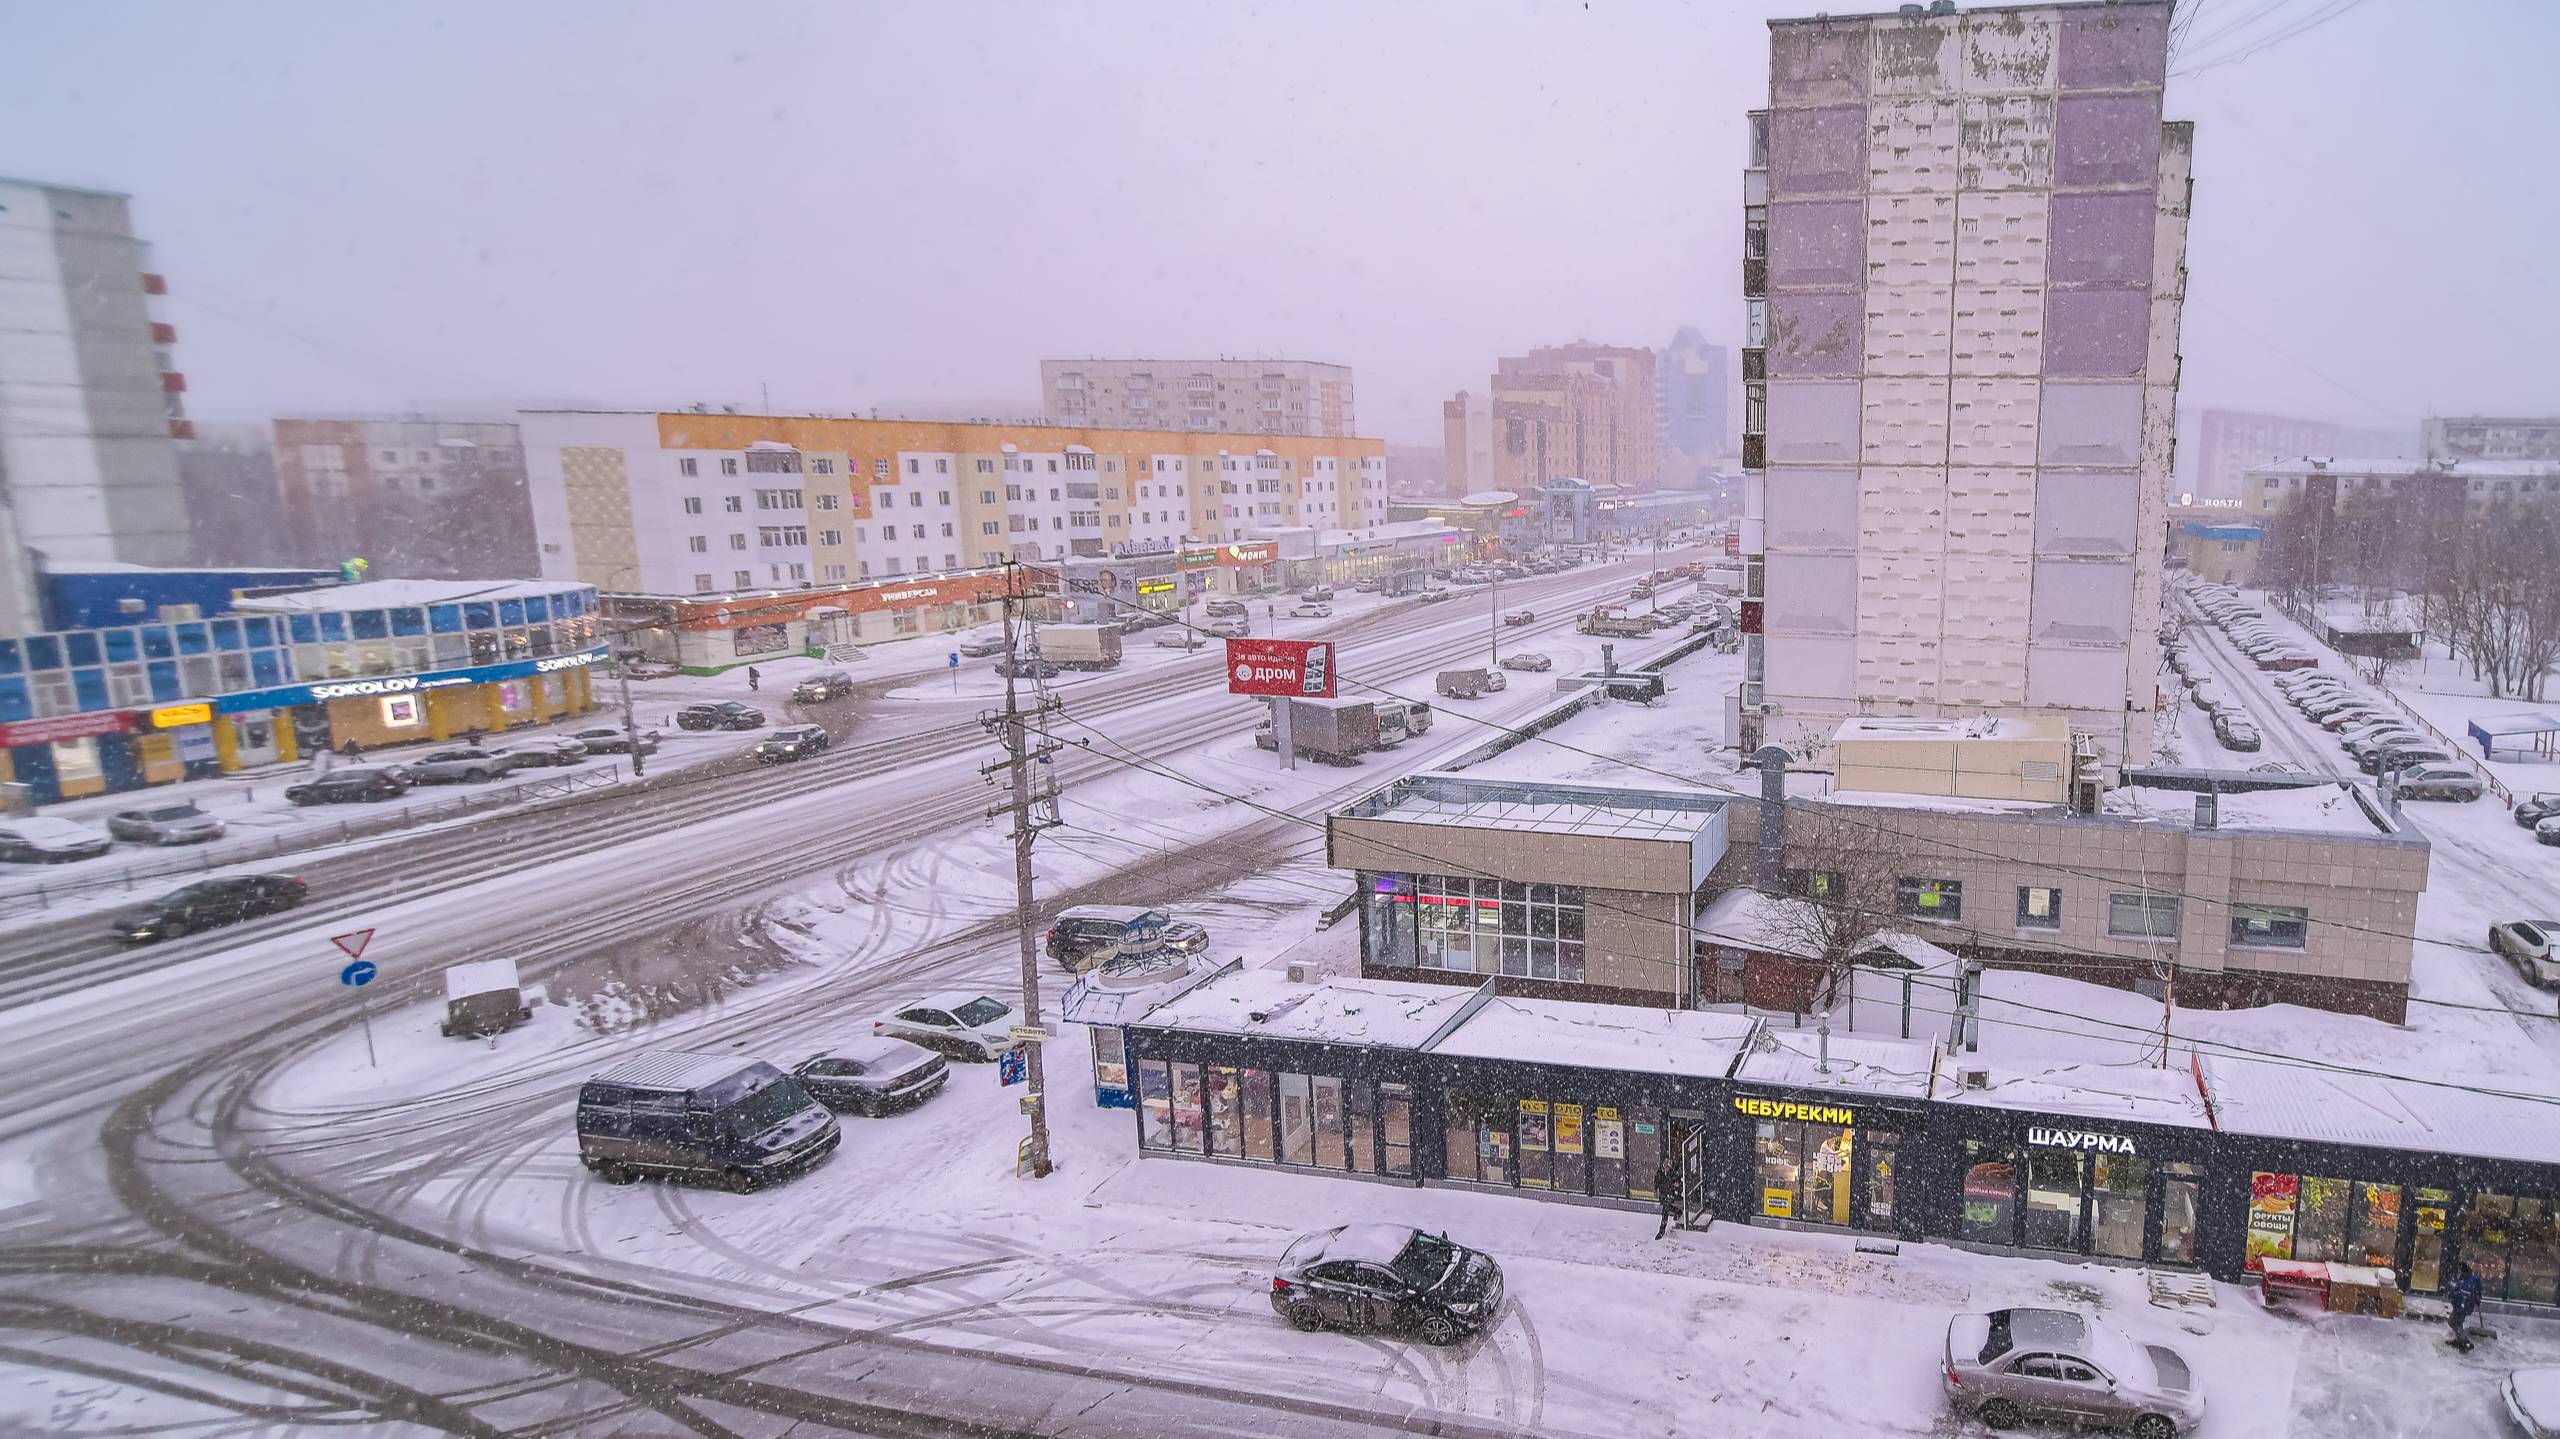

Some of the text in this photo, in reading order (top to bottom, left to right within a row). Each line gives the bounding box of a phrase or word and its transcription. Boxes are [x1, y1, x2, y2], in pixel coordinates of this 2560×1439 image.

[880, 588, 938, 602] УНИВЕРСАМ
[536, 653, 593, 672] SOKOLOV
[1255, 667, 1296, 682] дром
[310, 677, 419, 699] SOKOLOV
[1734, 1097, 1853, 1125] ЧЕБУРЕКМИ
[2028, 1127, 2136, 1154] ШАУРМА
[2254, 1212, 2291, 1222] ФРУКТЫ
[2253, 1221, 2288, 1231] ОВОЩИ
